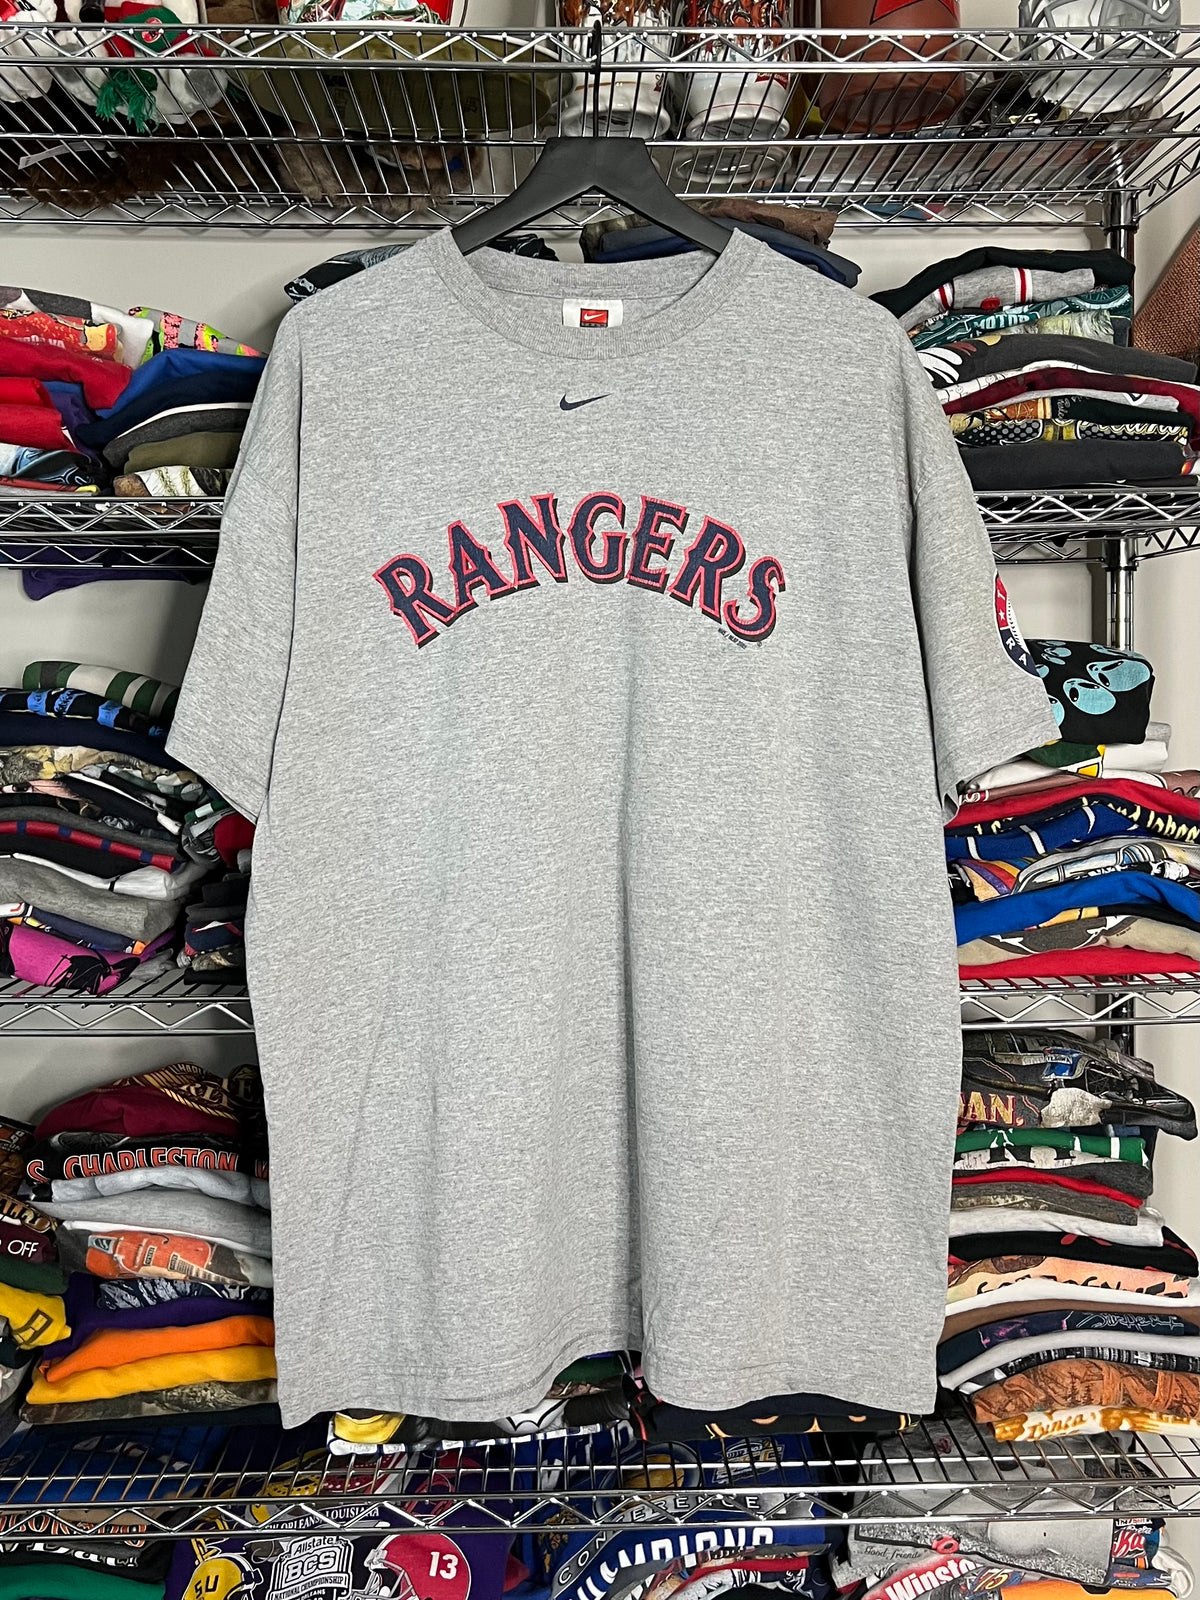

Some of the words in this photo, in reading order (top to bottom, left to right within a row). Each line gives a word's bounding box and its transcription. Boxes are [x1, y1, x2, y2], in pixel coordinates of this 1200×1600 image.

[372, 491, 786, 649] RANGERS
[957, 1090, 1026, 1127] AN,
[63, 1147, 239, 1180] CHARLESTON
[7, 1239, 40, 1258] OFF
[285, 1551, 336, 1581] BCS
[429, 1551, 459, 1580] 13
[885, 1558, 983, 1600] Winsto
